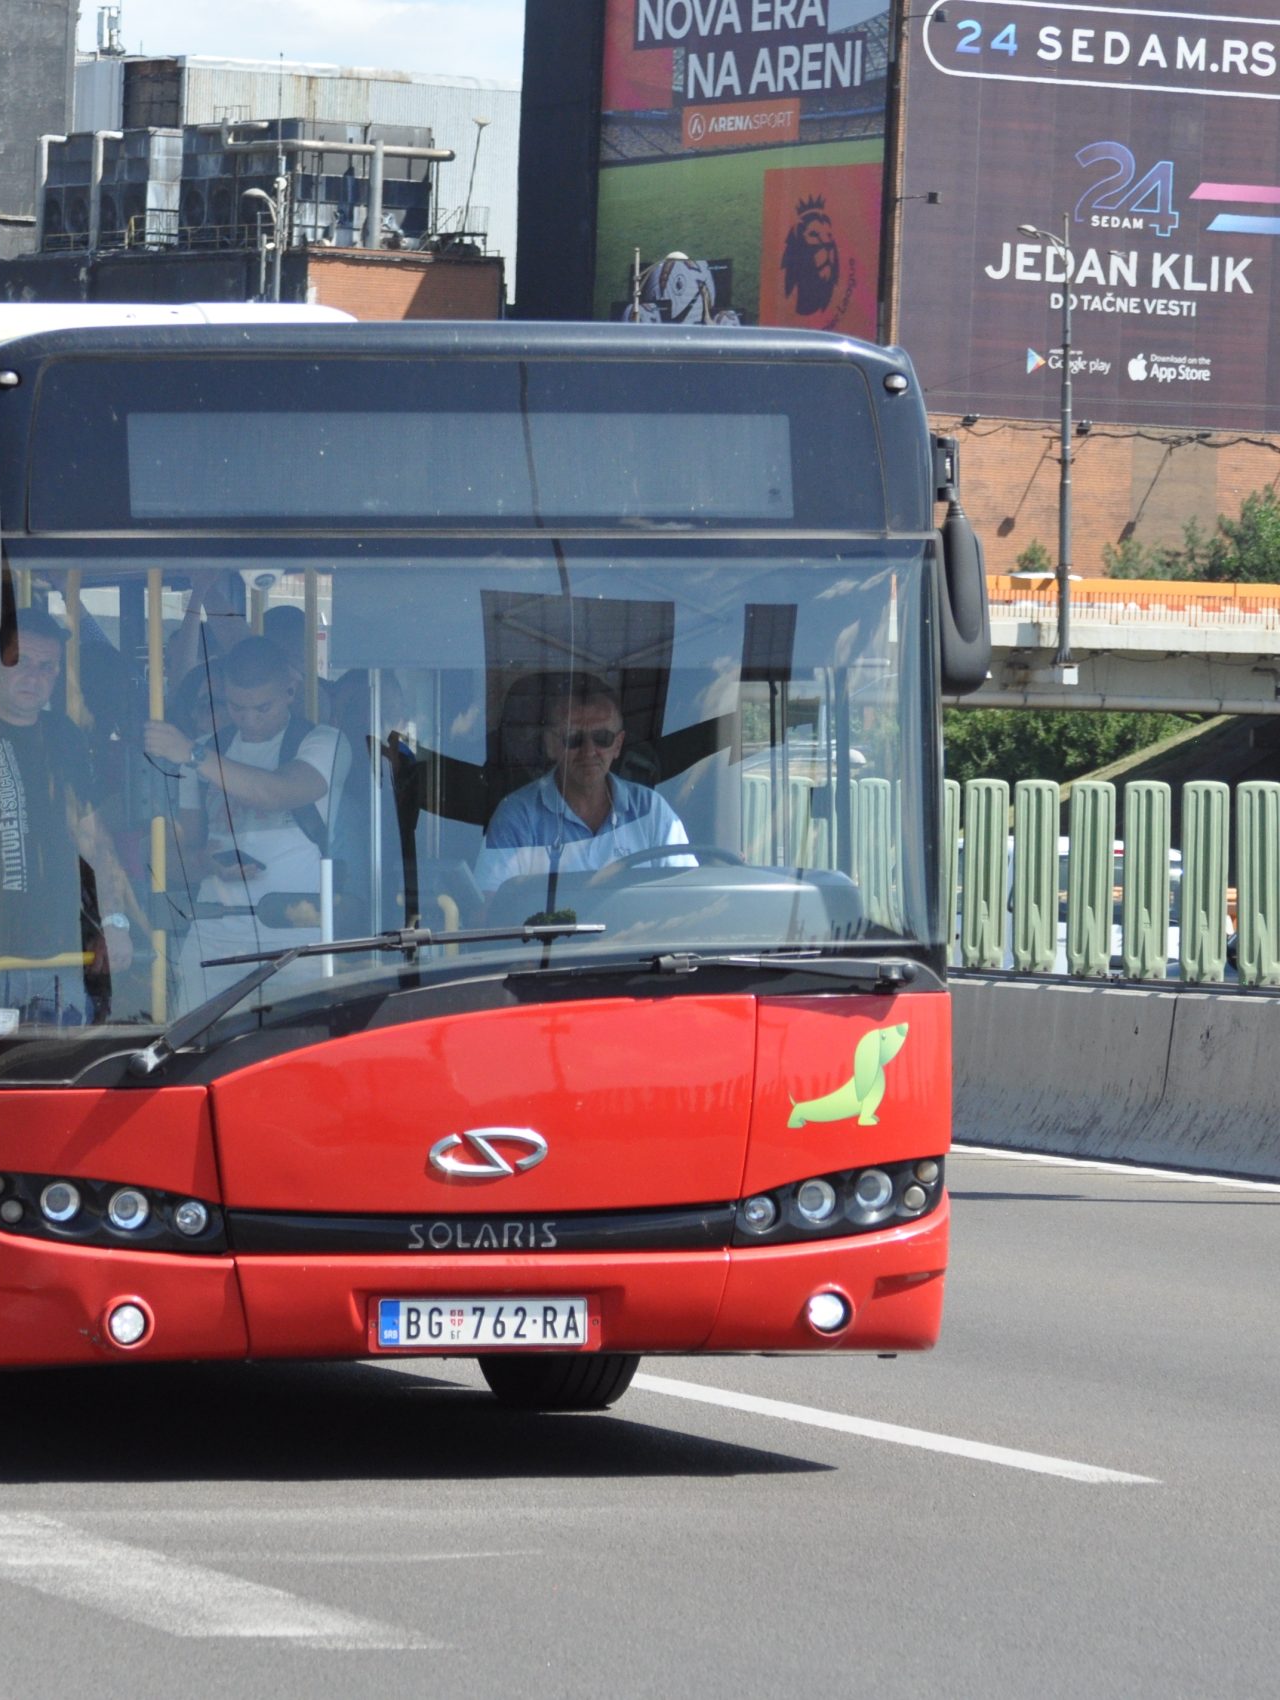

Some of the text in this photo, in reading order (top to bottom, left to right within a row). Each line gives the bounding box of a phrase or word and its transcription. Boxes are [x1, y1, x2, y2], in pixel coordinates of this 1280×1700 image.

[638, 0, 825, 41] NOVA ERA
[956, 20, 1277, 77] 24 SEDAM.RS
[687, 40, 863, 99] NA ARENI
[1091, 214, 1144, 230] SEDAM
[985, 242, 1254, 294] JEDAN KLIK
[1144, 298, 1197, 318] VESTI
[1150, 365, 1211, 383] App Store
[408, 1221, 557, 1249] SOLARIS
[406, 1306, 443, 1339] BG
